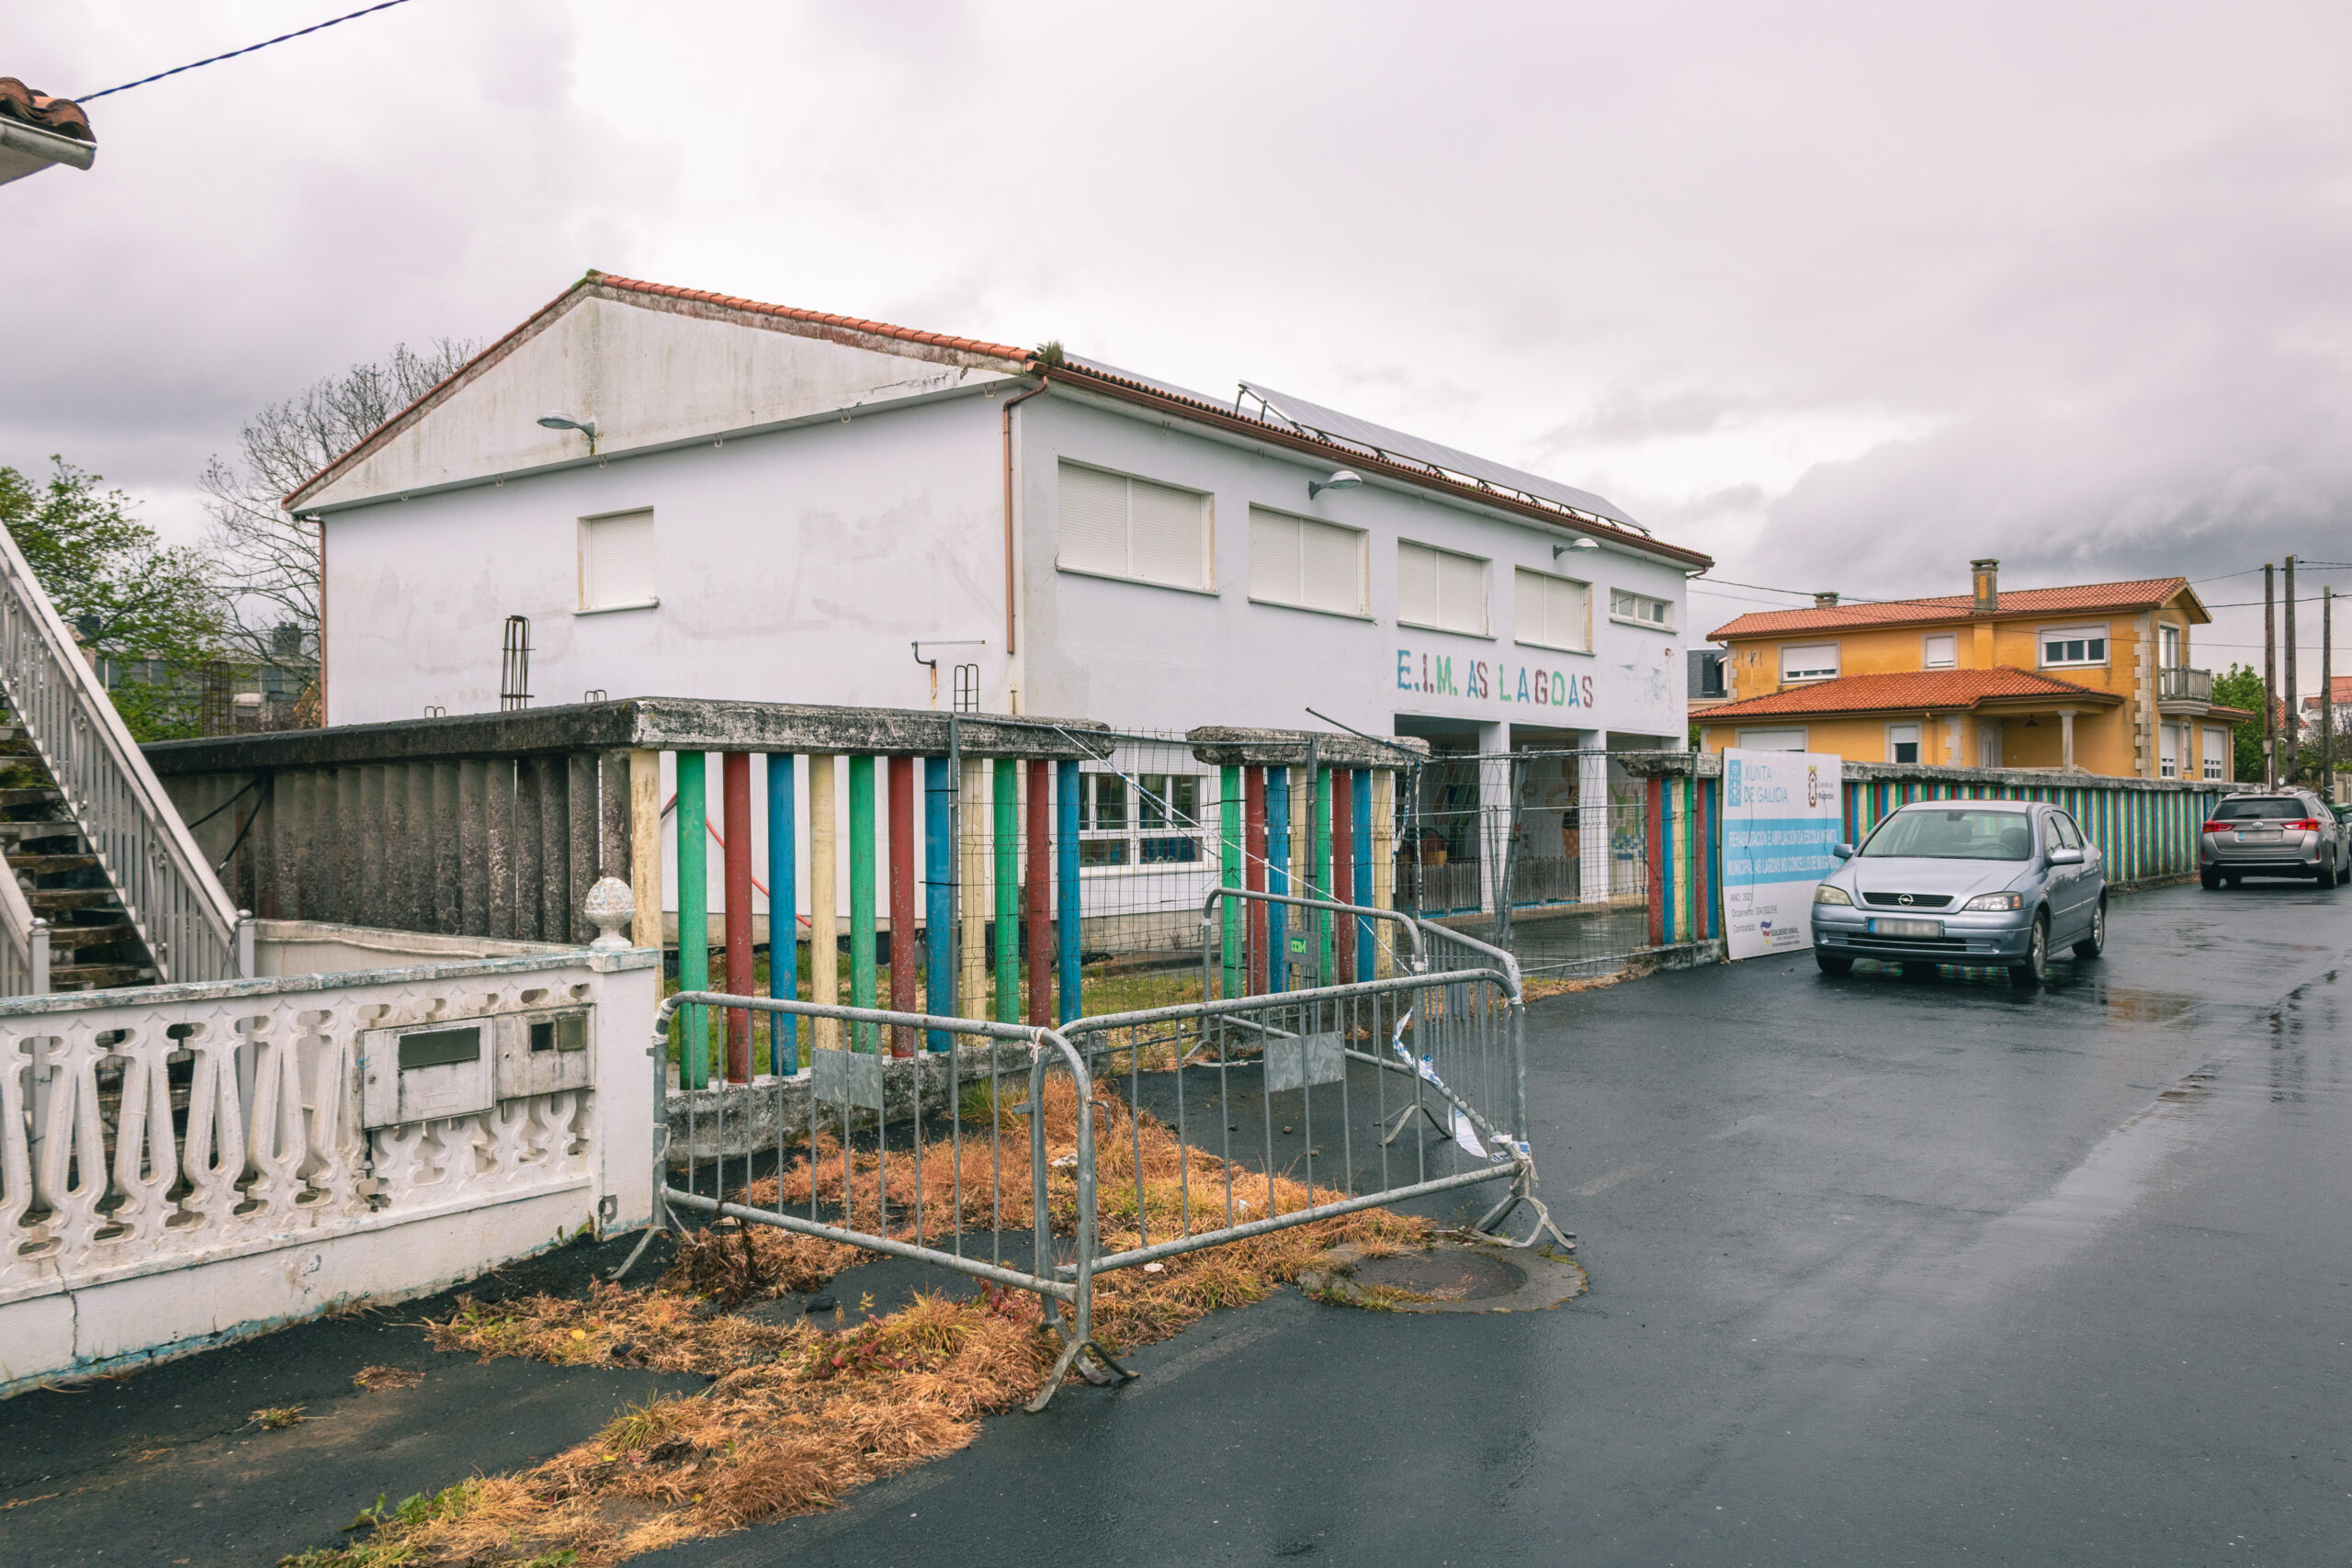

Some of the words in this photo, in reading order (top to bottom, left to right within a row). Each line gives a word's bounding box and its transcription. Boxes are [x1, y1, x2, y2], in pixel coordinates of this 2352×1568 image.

[1397, 649, 1458, 696] E.I.M.
[1467, 660, 1488, 699] AS
[1499, 663, 1594, 708] LAGOAS
[1745, 764, 1771, 781] XUNTA
[1744, 786, 1755, 803] DE
[1757, 786, 1788, 803] GALICIA
